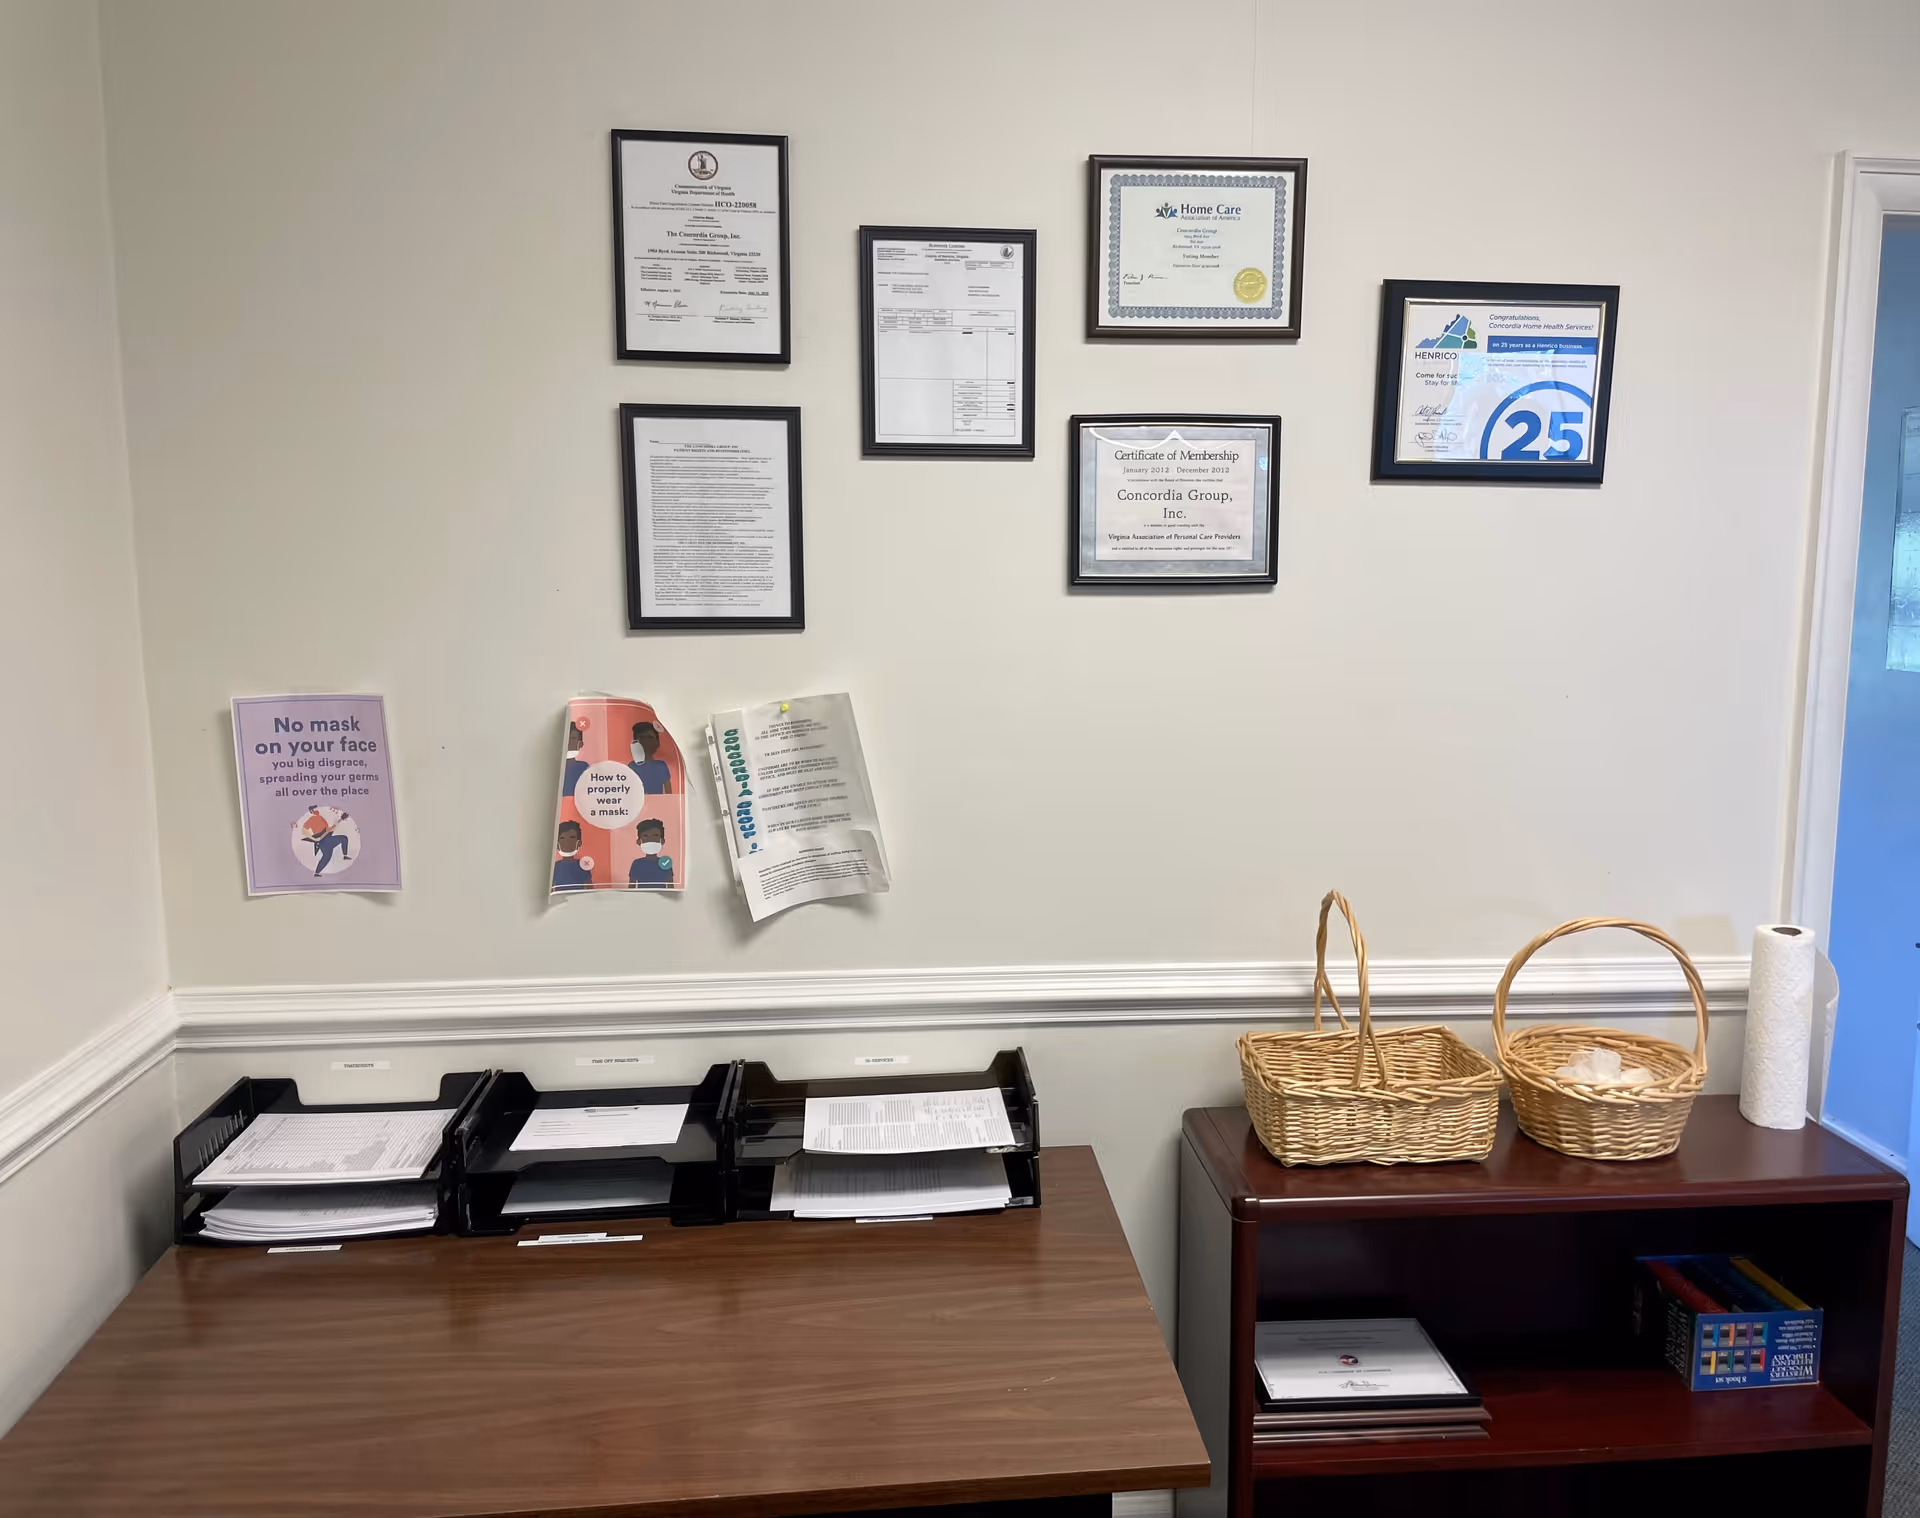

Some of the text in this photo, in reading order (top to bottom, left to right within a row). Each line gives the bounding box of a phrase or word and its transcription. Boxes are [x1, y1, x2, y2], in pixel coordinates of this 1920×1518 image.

[1181, 204, 1241, 214] Home Care
[1415, 352, 1457, 360] HENRICO
[1501, 410, 1584, 460] 25
[1114, 450, 1239, 463] Certificate of Membership
[1117, 489, 1233, 503] Concordia Group,
[1163, 508, 1186, 519] Inc.
[274, 716, 360, 733] No mask
[255, 736, 377, 756] on your face
[272, 758, 368, 770] you big disgrace,
[260, 773, 379, 785] spreading your germs
[590, 774, 613, 782] How
[275, 786, 369, 796] all over the place
[587, 785, 630, 795] properly
[596, 797, 622, 805] wear
[599, 808, 628, 816] mask:
[1772, 1352, 1814, 1361] LIBRARY
[1727, 1376, 1742, 1384] book
